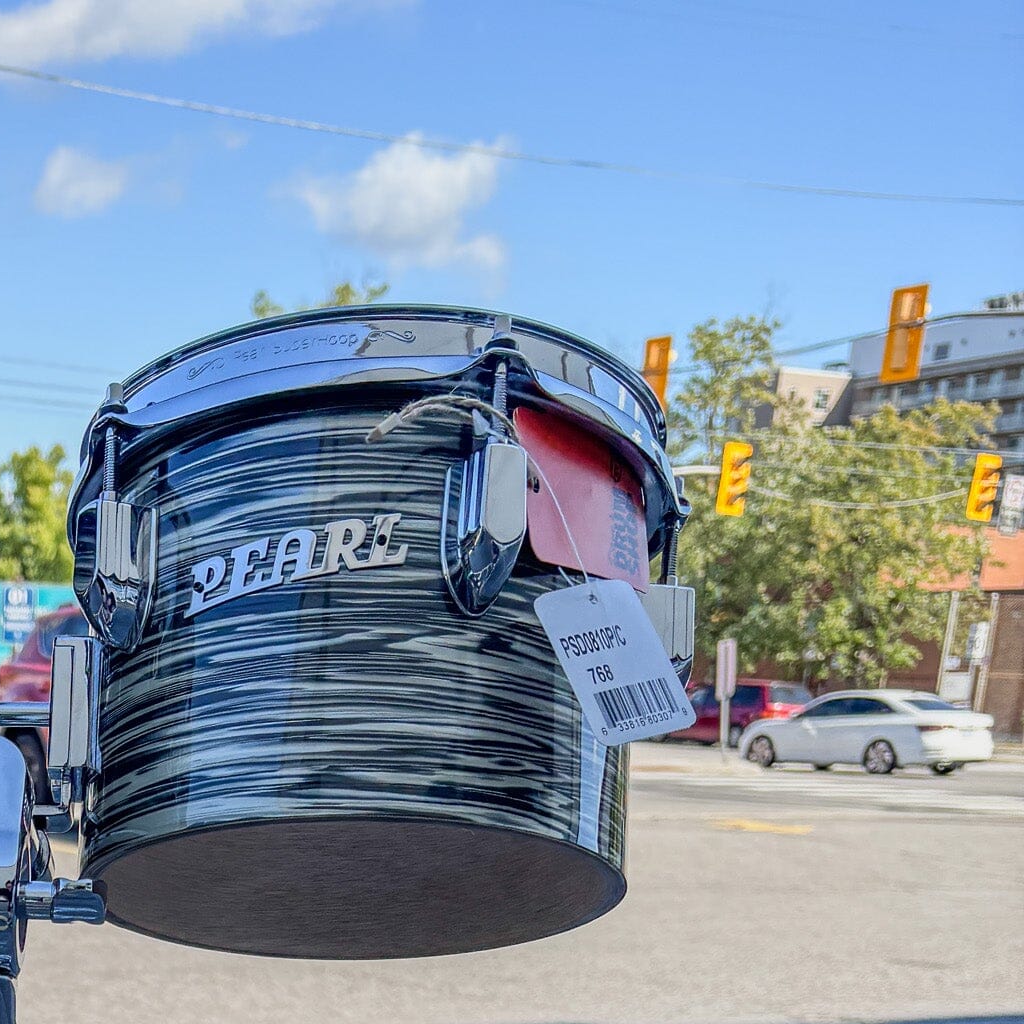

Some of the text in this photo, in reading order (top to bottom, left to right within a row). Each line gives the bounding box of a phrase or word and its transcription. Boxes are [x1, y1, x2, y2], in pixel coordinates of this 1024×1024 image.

[184, 513, 408, 619] PEARL
[559, 625, 627, 659] PSD0810P/C
[587, 664, 614, 685] 768
[601, 727, 608, 736] 6
